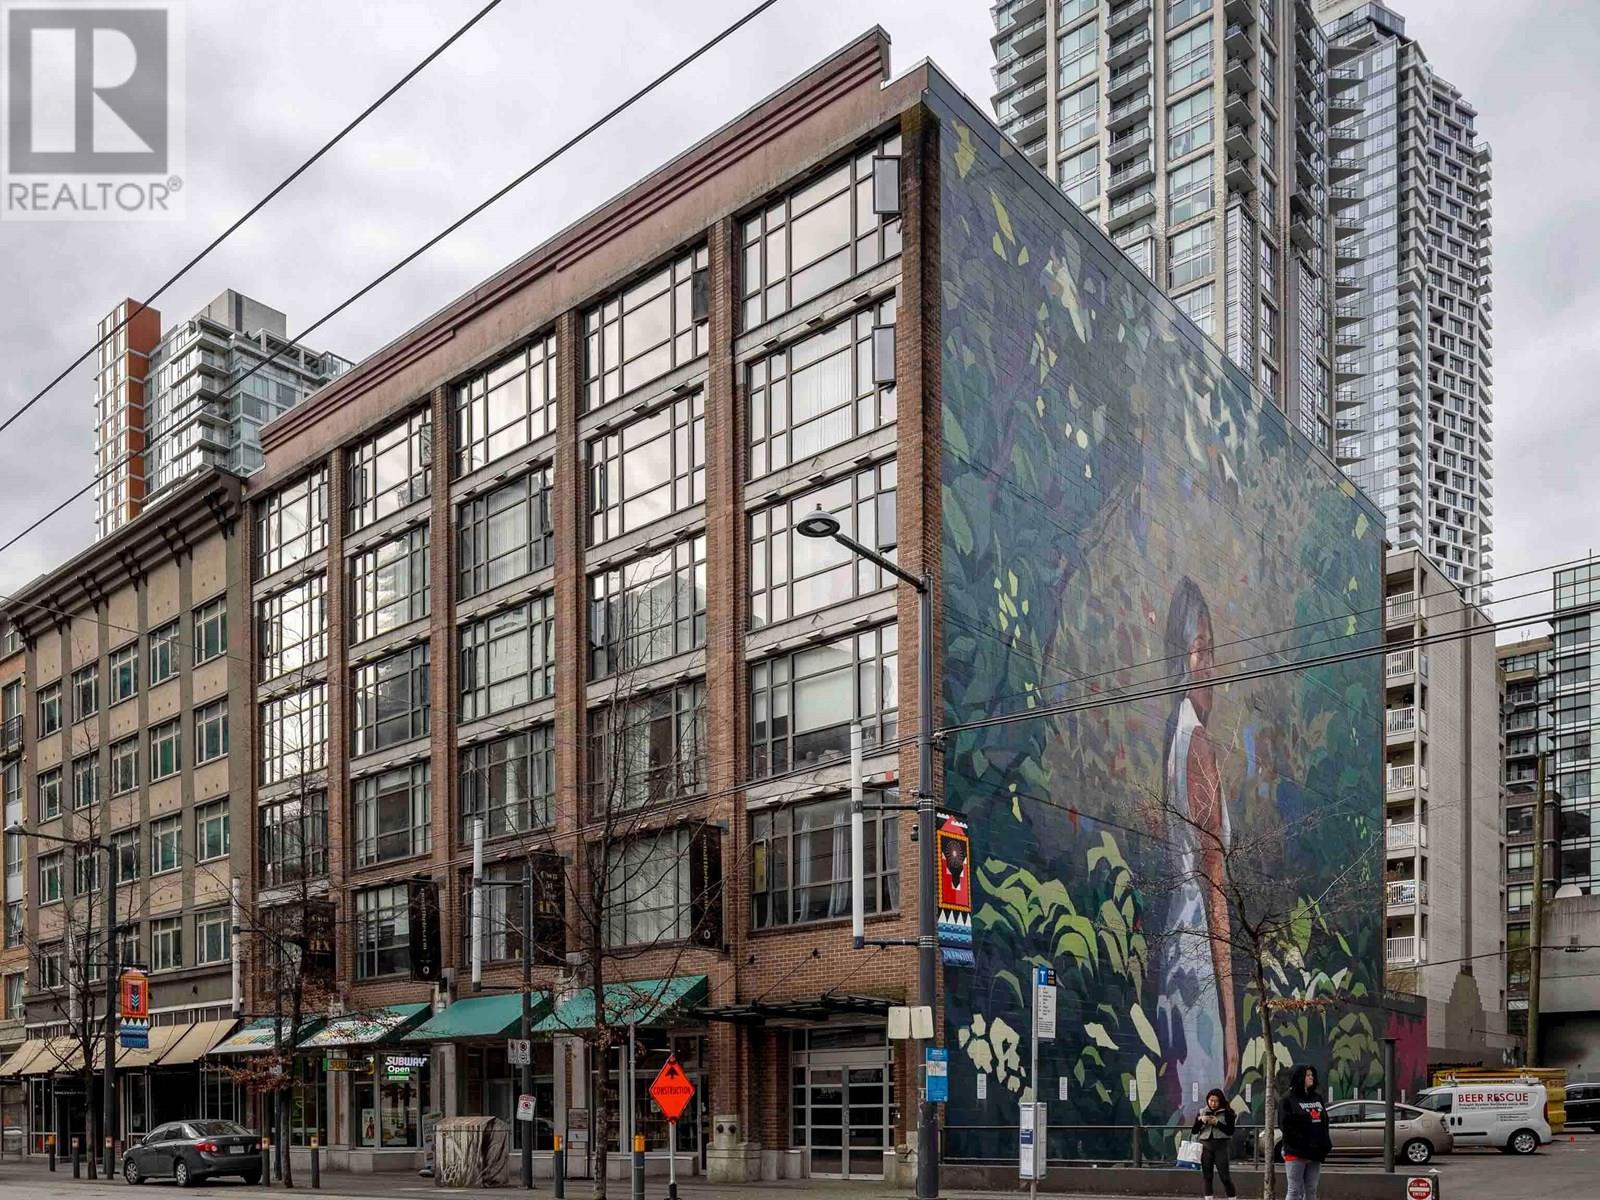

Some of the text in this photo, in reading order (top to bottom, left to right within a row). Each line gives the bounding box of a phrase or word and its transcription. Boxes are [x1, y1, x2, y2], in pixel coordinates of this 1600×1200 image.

[385, 1056, 427, 1067] SUBWAY
[387, 1065, 410, 1074] Open
[653, 1086, 691, 1096] CONSTRUCTION
[1458, 1092, 1529, 1103] BEER RESCUE
